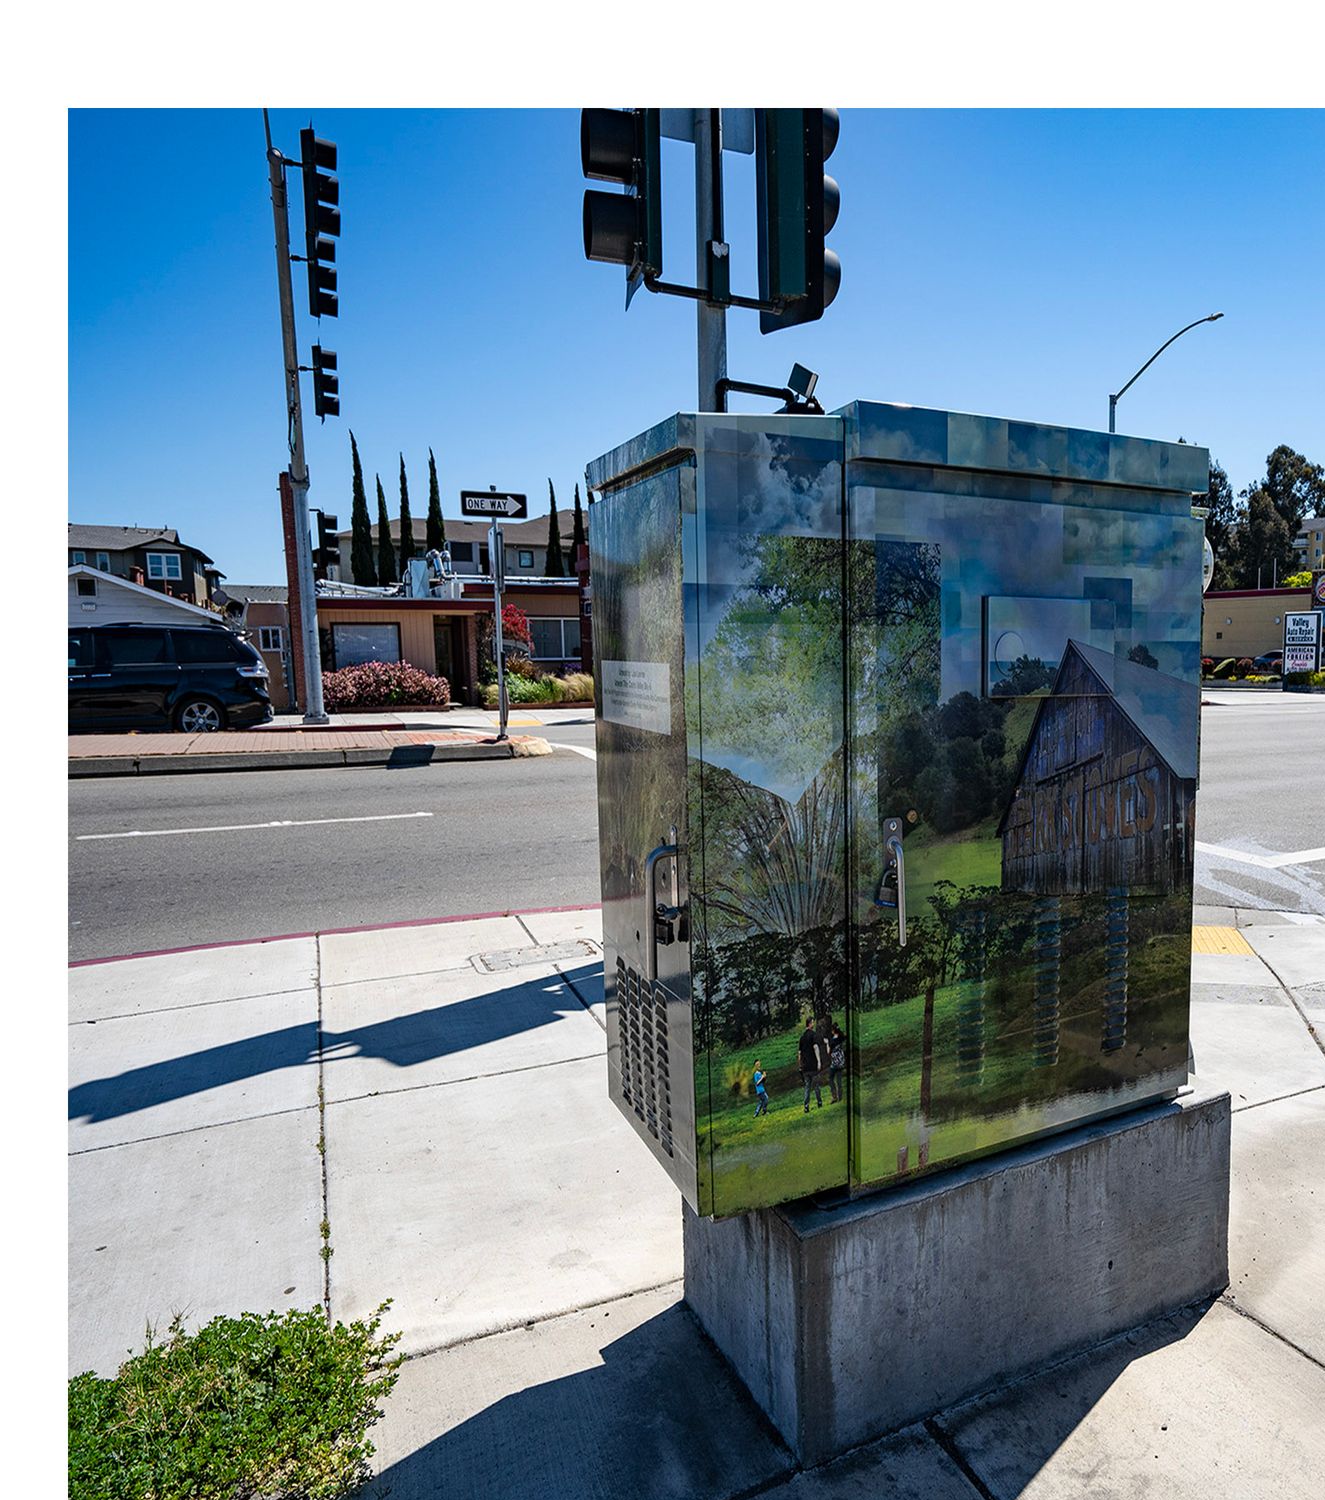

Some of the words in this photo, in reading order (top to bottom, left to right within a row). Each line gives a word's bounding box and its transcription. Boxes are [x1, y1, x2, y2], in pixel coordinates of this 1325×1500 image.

[467, 498, 486, 509] ONE
[490, 500, 507, 510] WAY
[1292, 618, 1309, 628] Valley
[1299, 627, 1315, 637] Repair
